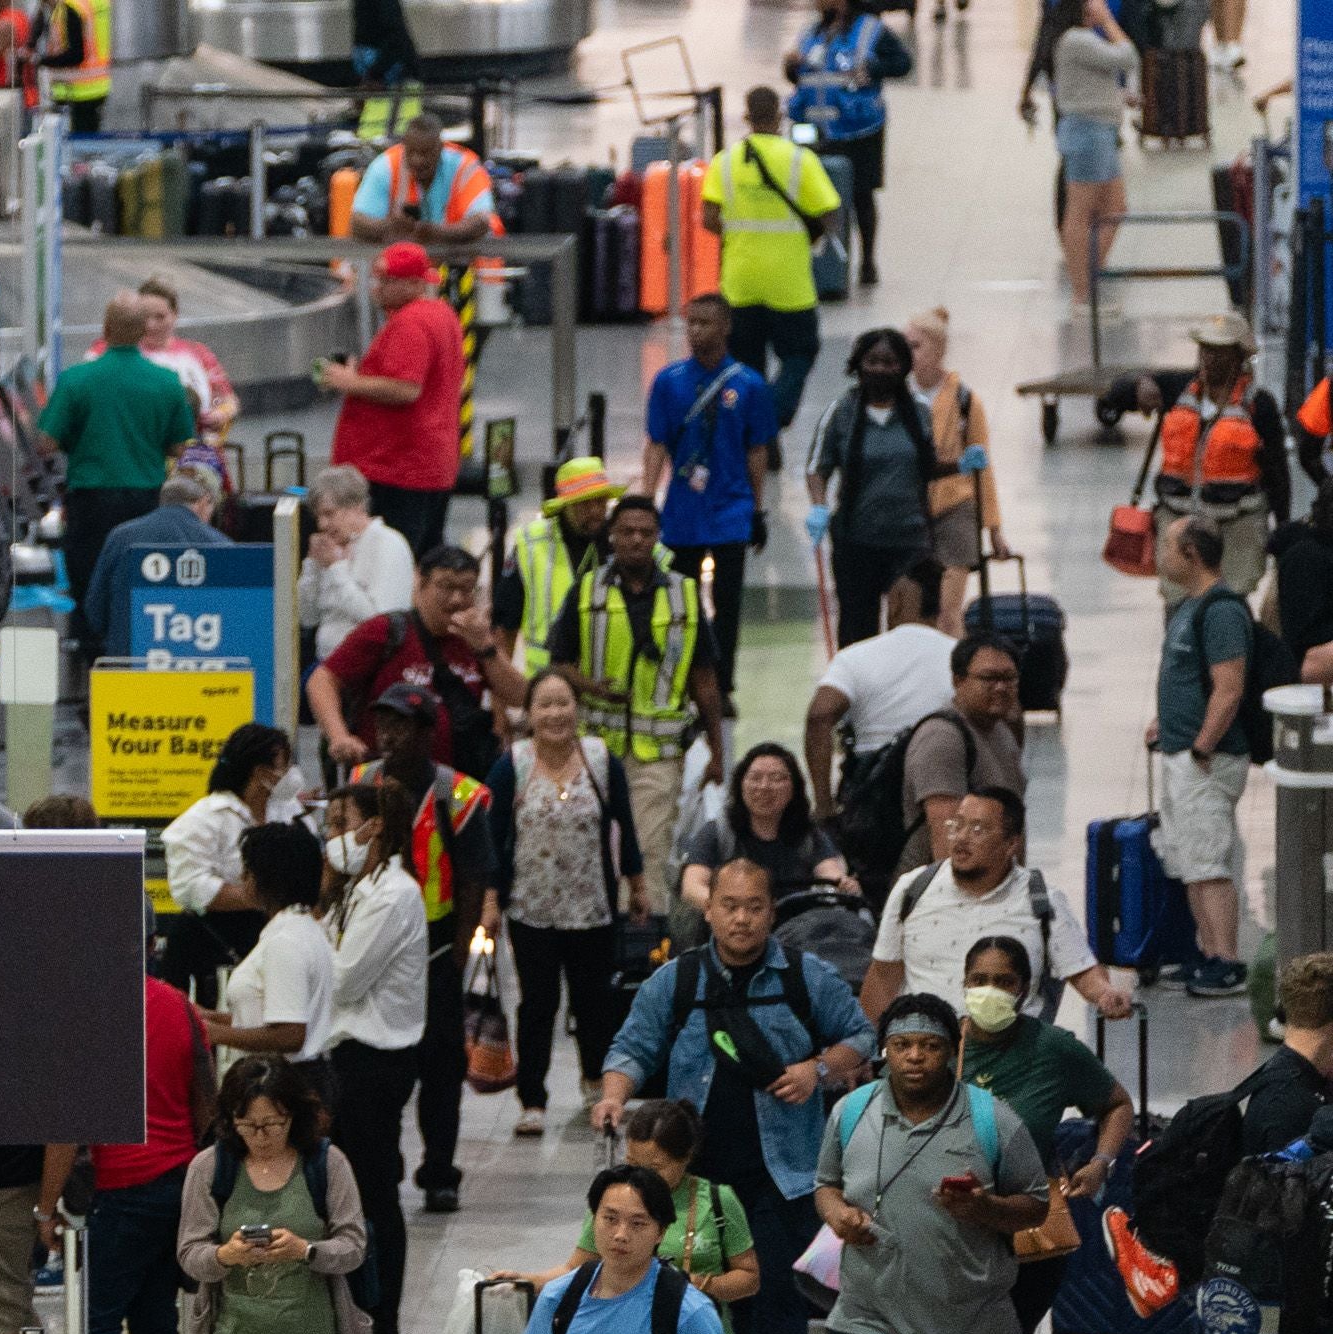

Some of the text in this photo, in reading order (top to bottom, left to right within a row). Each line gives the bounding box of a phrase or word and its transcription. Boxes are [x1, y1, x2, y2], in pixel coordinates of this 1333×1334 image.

[143, 603, 222, 650] Tag
[107, 712, 207, 731] Measure
[107, 735, 161, 755] Your
